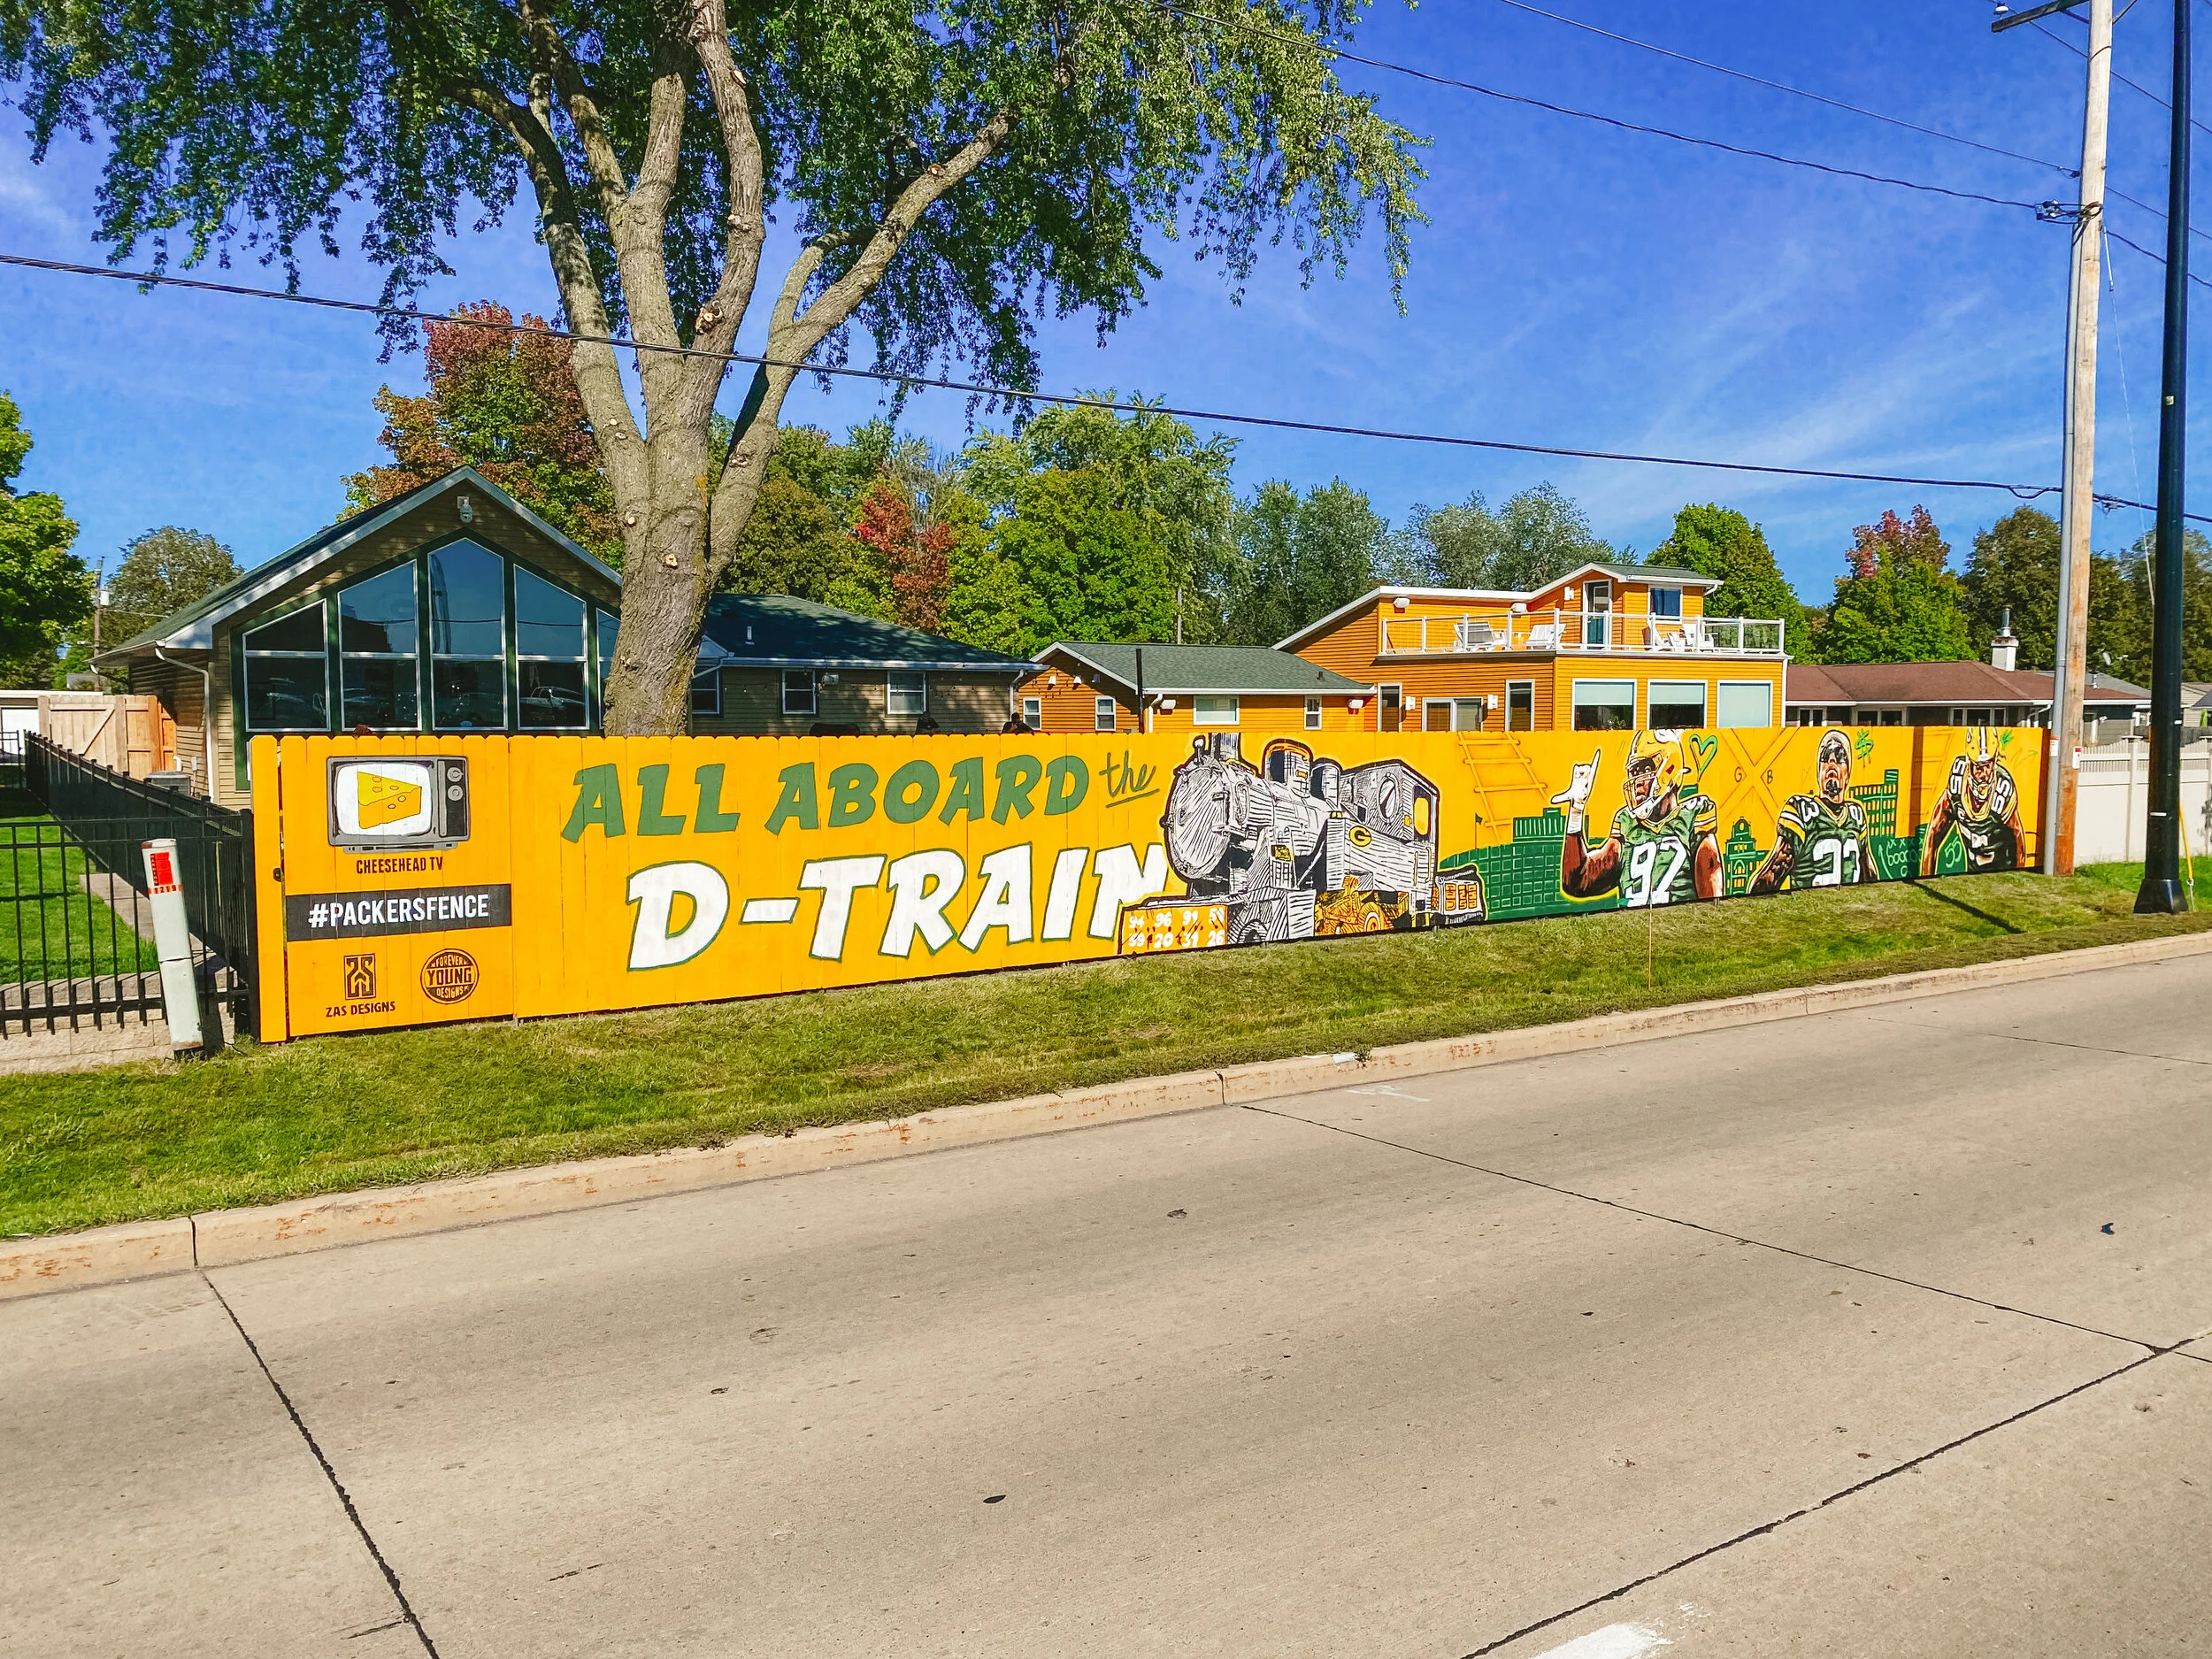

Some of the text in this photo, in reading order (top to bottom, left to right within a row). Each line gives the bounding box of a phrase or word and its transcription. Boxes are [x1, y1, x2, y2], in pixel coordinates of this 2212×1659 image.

[561, 750, 1156, 843] ALL ABOARD the
[356, 856, 443, 874] CHEESEHEAD TV
[1625, 835, 1687, 908] 97
[308, 894, 489, 928] #PACKERSFENCE
[626, 841, 1169, 972] D-TRAIN
[1154, 912, 1172, 927] 96
[1182, 910, 1198, 926] 91
[1153, 932, 1174, 949] 20
[1207, 930, 1225, 947] 26
[426, 967, 472, 987] YOUNG
[436, 986, 464, 999] DESIGNS
[326, 1001, 396, 1018] ZAS DESIGNS
